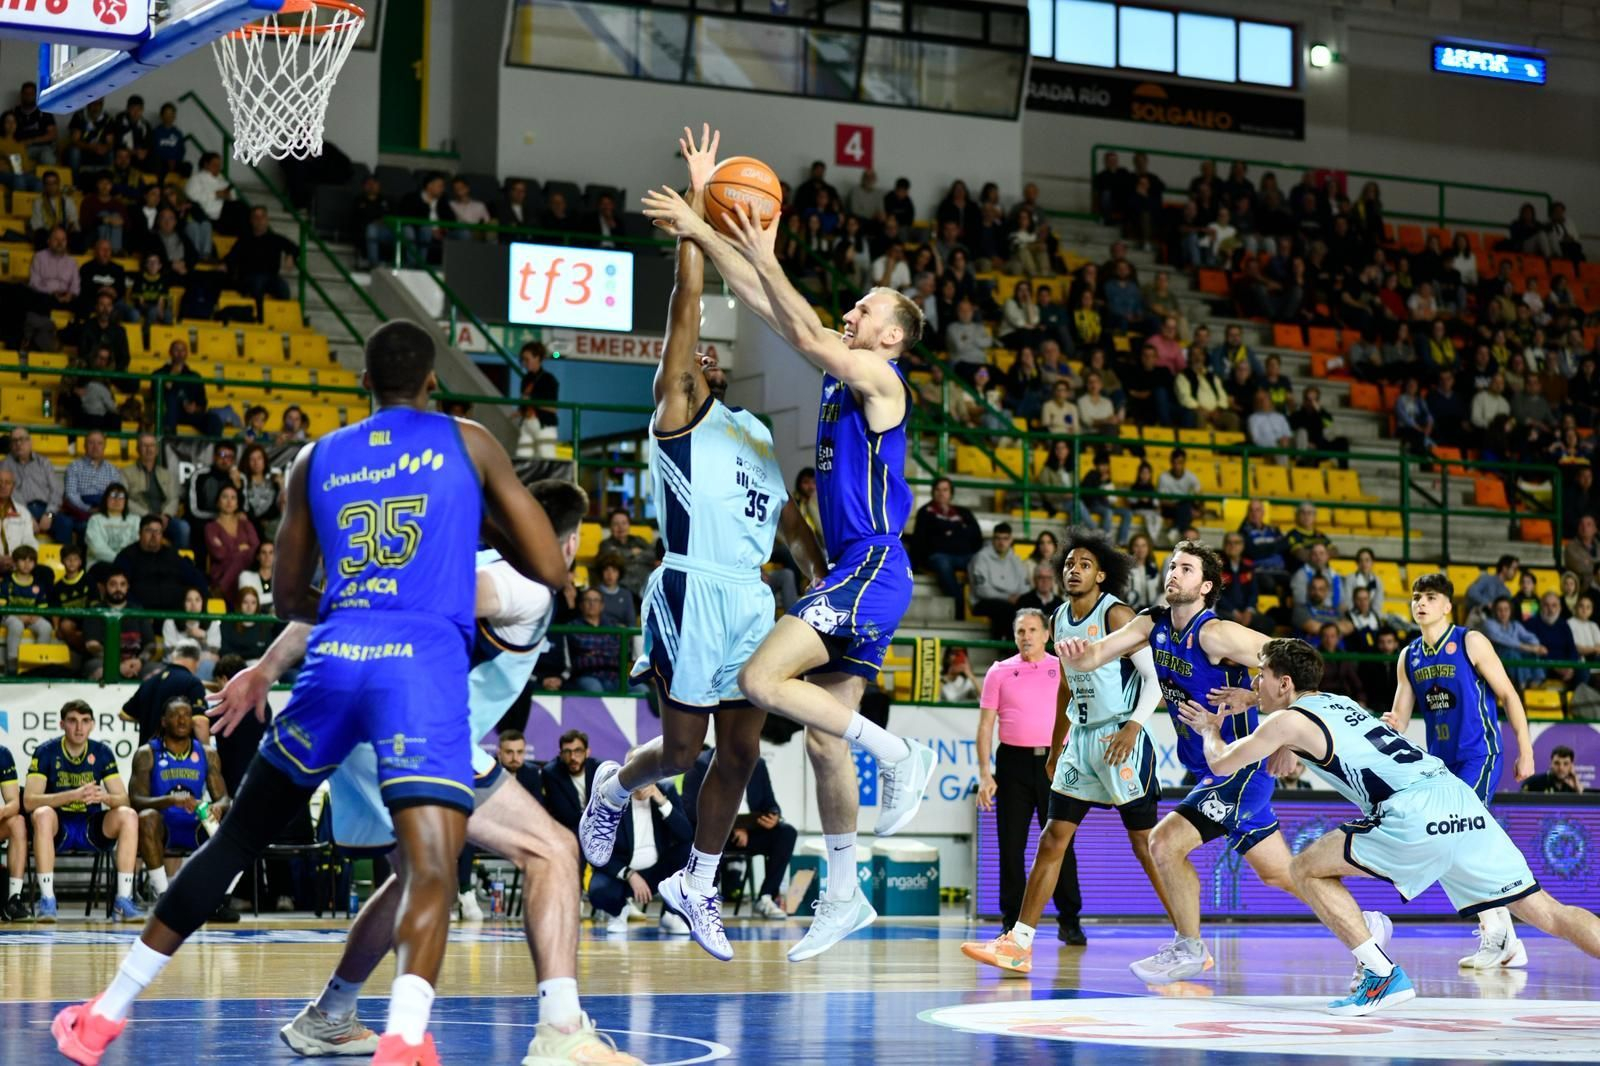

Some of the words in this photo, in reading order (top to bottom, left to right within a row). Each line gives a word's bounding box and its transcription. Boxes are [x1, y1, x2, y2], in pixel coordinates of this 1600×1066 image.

[1130, 101, 1233, 130] SOLGALEO
[843, 130, 865, 162] 4
[518, 257, 593, 314] tf3
[369, 430, 392, 446] GILL
[744, 488, 771, 523] 35
[337, 494, 428, 579] 35
[1077, 702, 1088, 725] 5
[1363, 725, 1424, 765] 5
